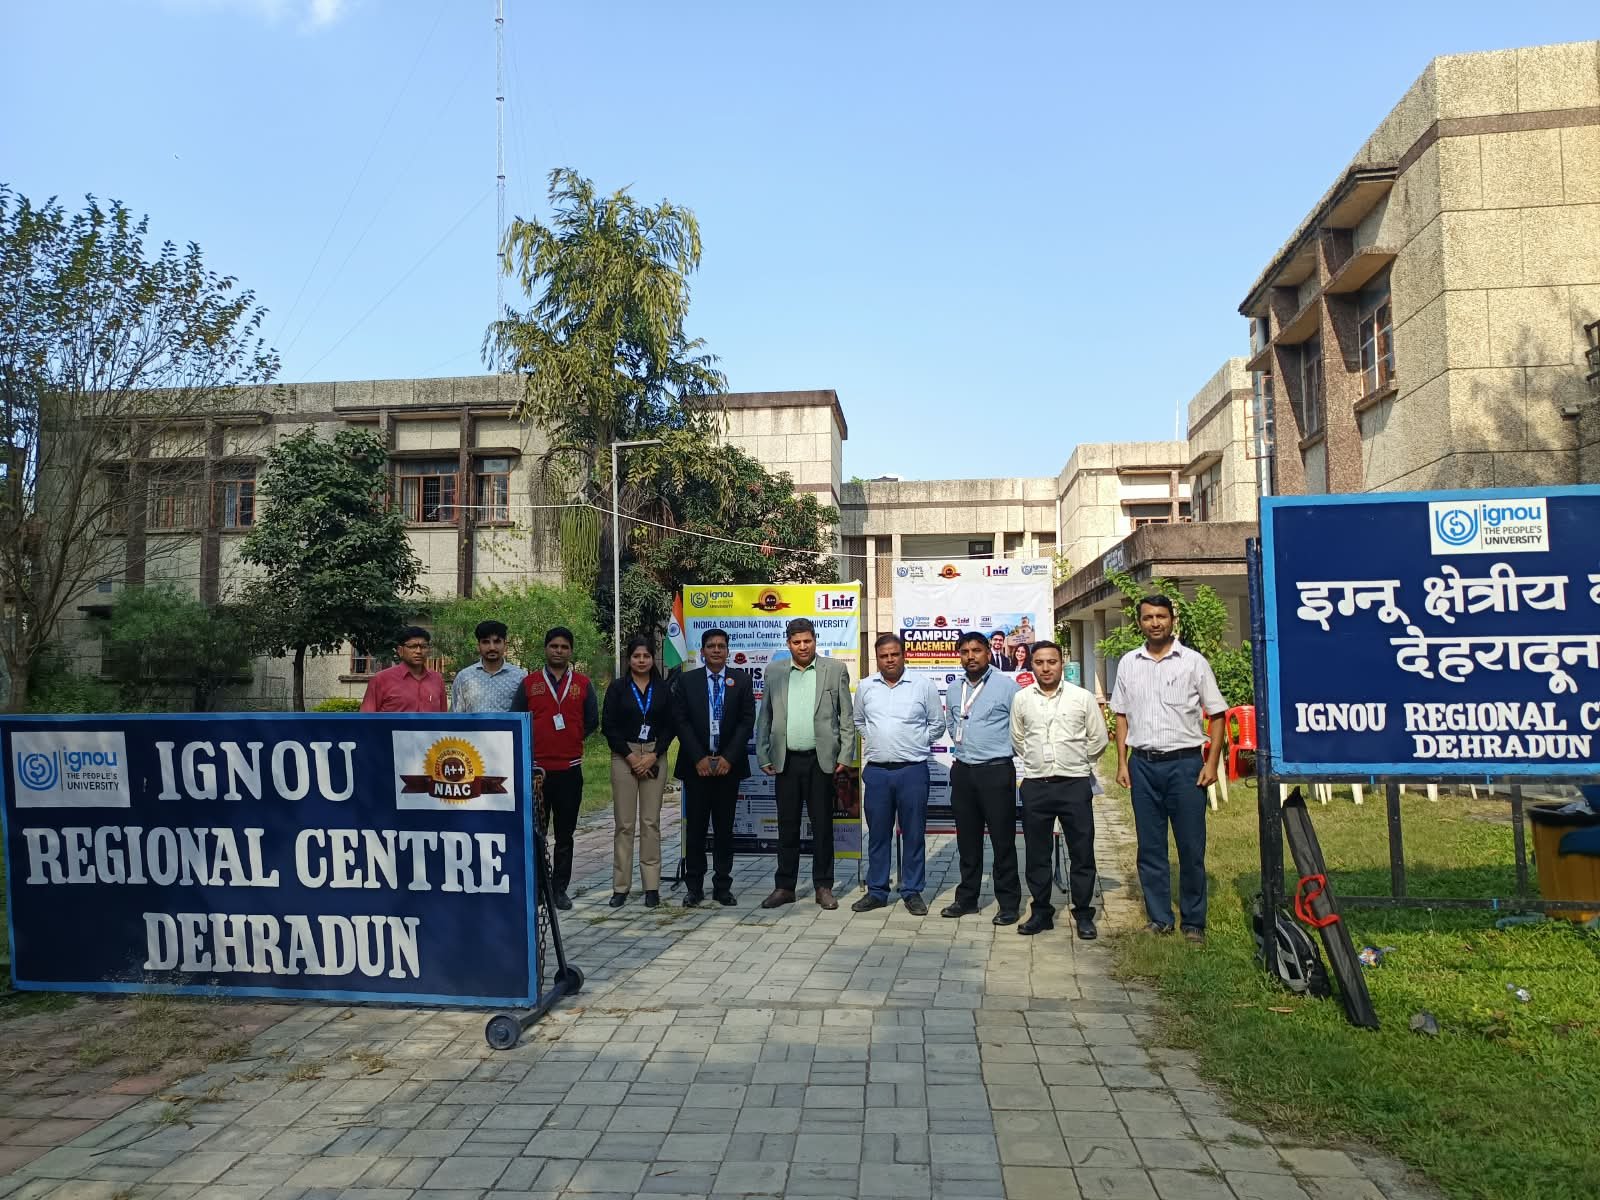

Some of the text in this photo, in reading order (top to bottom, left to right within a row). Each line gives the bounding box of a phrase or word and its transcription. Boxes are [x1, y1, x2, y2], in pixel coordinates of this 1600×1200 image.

[1482, 504, 1541, 526] ignou
[1484, 525, 1542, 535] THE PEOPLE'S
[1485, 535, 1542, 545] UNIVERSITY
[993, 565, 1009, 575] nirf
[710, 590, 734, 600] ignou
[1423, 562, 1569, 624] क्षेत्रीय
[832, 594, 855, 607] nirf
[693, 620, 717, 629] INDIRA
[720, 620, 746, 629] GANDHI
[748, 620, 783, 629] NATIONAL
[812, 619, 849, 628] NIVERSITY
[727, 632, 754, 640] egional
[904, 630, 960, 641] CAMPUS
[904, 641, 957, 652] PLACEMENT
[1390, 625, 1600, 694] देहरादून
[1295, 702, 1387, 732] IGNOU
[1403, 701, 1567, 732] REGIONAL
[1412, 734, 1592, 759] DEHRADUN
[63, 745, 118, 772] ignou
[66, 772, 118, 780] THE PEOPLE'S
[156, 741, 357, 801] IGNOU
[444, 764, 465, 776] A++
[67, 782, 119, 791] UNIVERSITY
[22, 826, 510, 893] REGIONAL CENTRE
[143, 912, 420, 979] DEHRADUN
